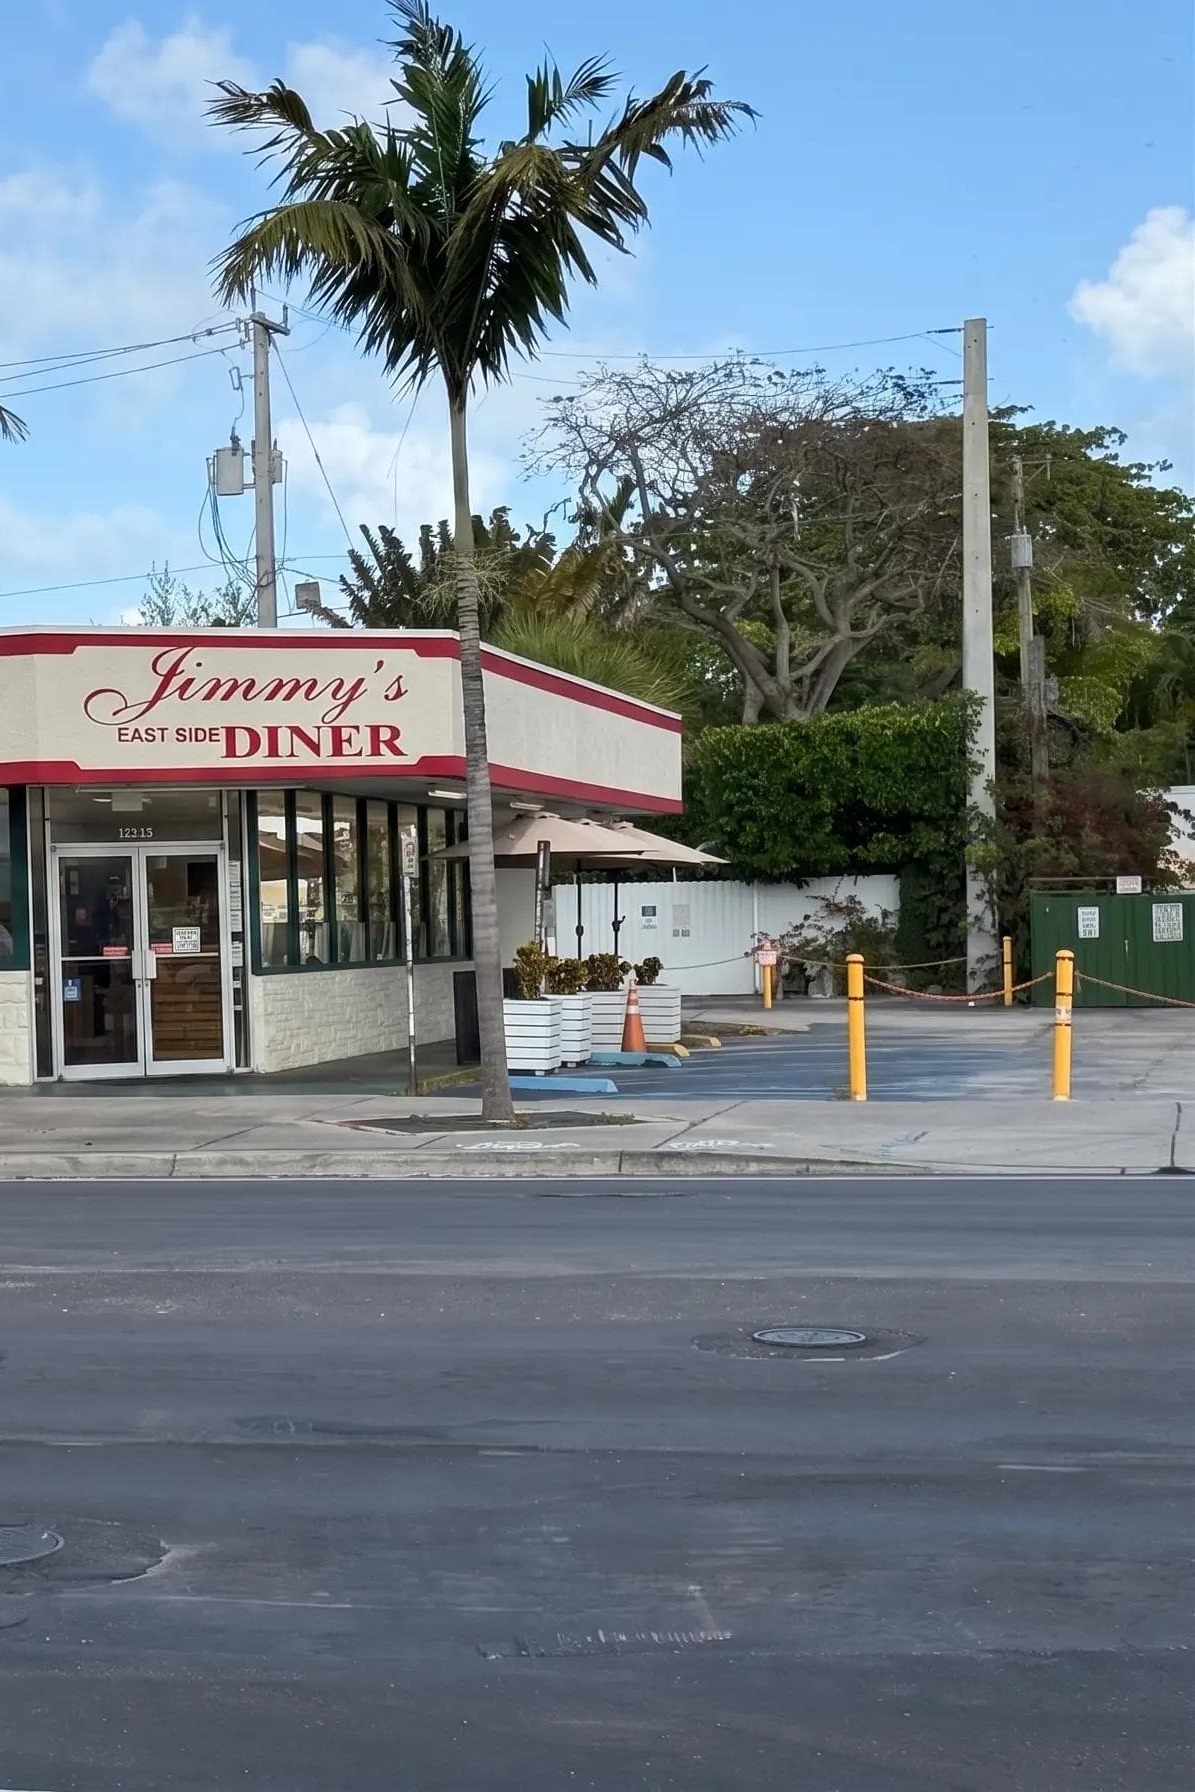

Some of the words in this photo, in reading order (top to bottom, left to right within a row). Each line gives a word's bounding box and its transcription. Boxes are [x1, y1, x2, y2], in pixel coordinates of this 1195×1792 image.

[83, 646, 409, 725] Jimmy's
[117, 727, 168, 743] EAST
[175, 726, 220, 743] SIDE
[220, 724, 409, 758] DINER
